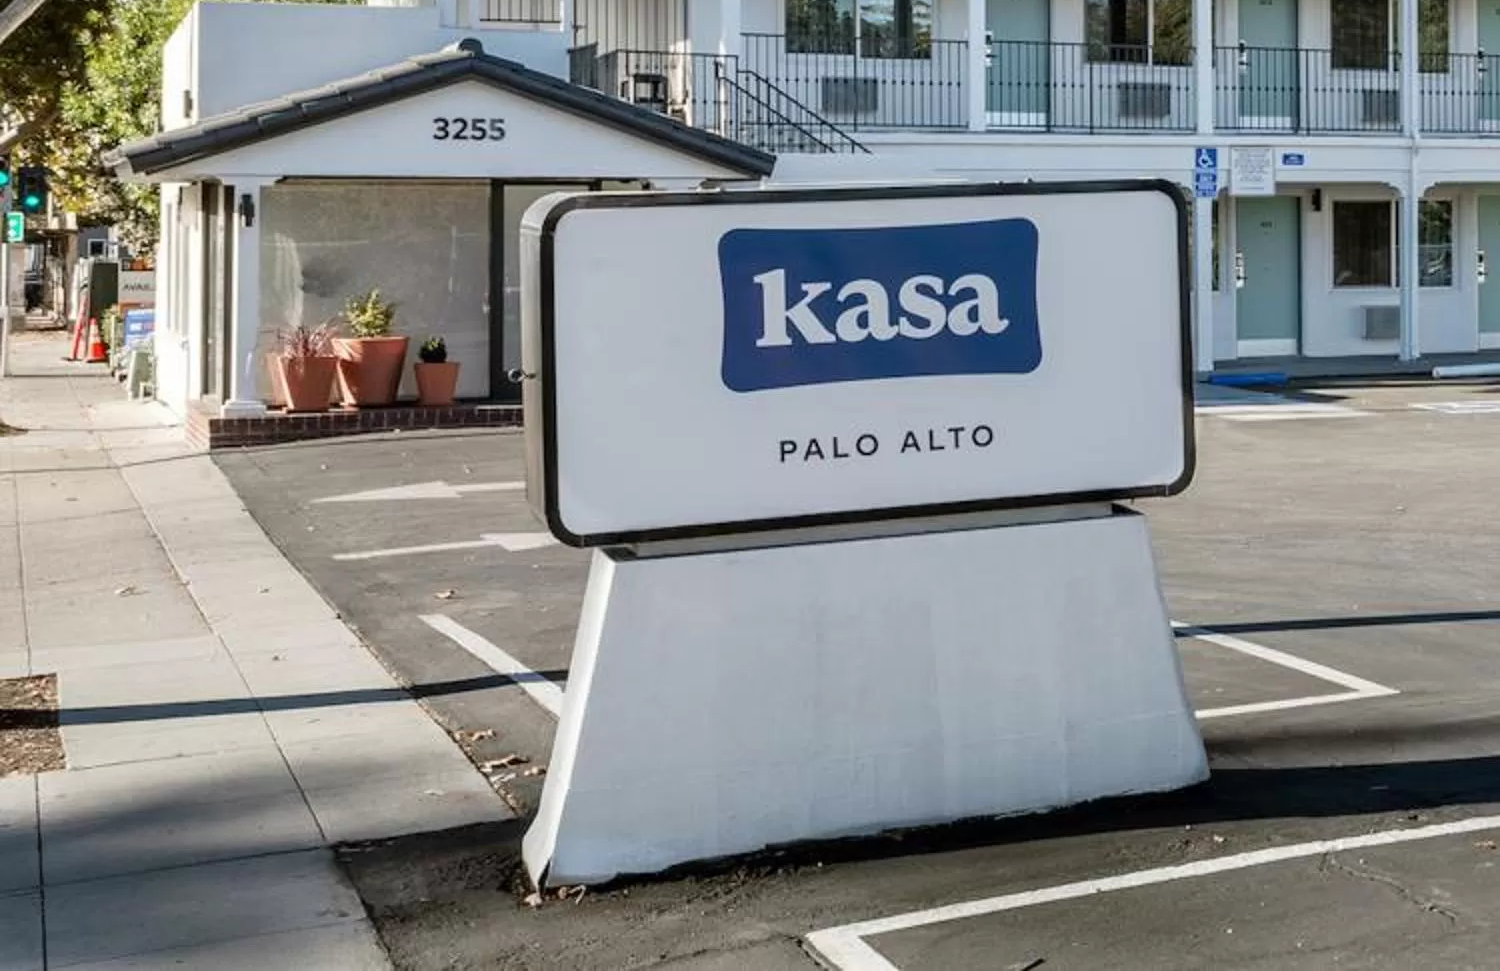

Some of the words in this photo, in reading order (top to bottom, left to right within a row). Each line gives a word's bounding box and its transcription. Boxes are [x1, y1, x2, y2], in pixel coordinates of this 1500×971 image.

[432, 116, 506, 141] 3255
[753, 268, 1010, 348] kasa
[779, 433, 879, 463] PALO
[900, 424, 994, 454] ALTO
